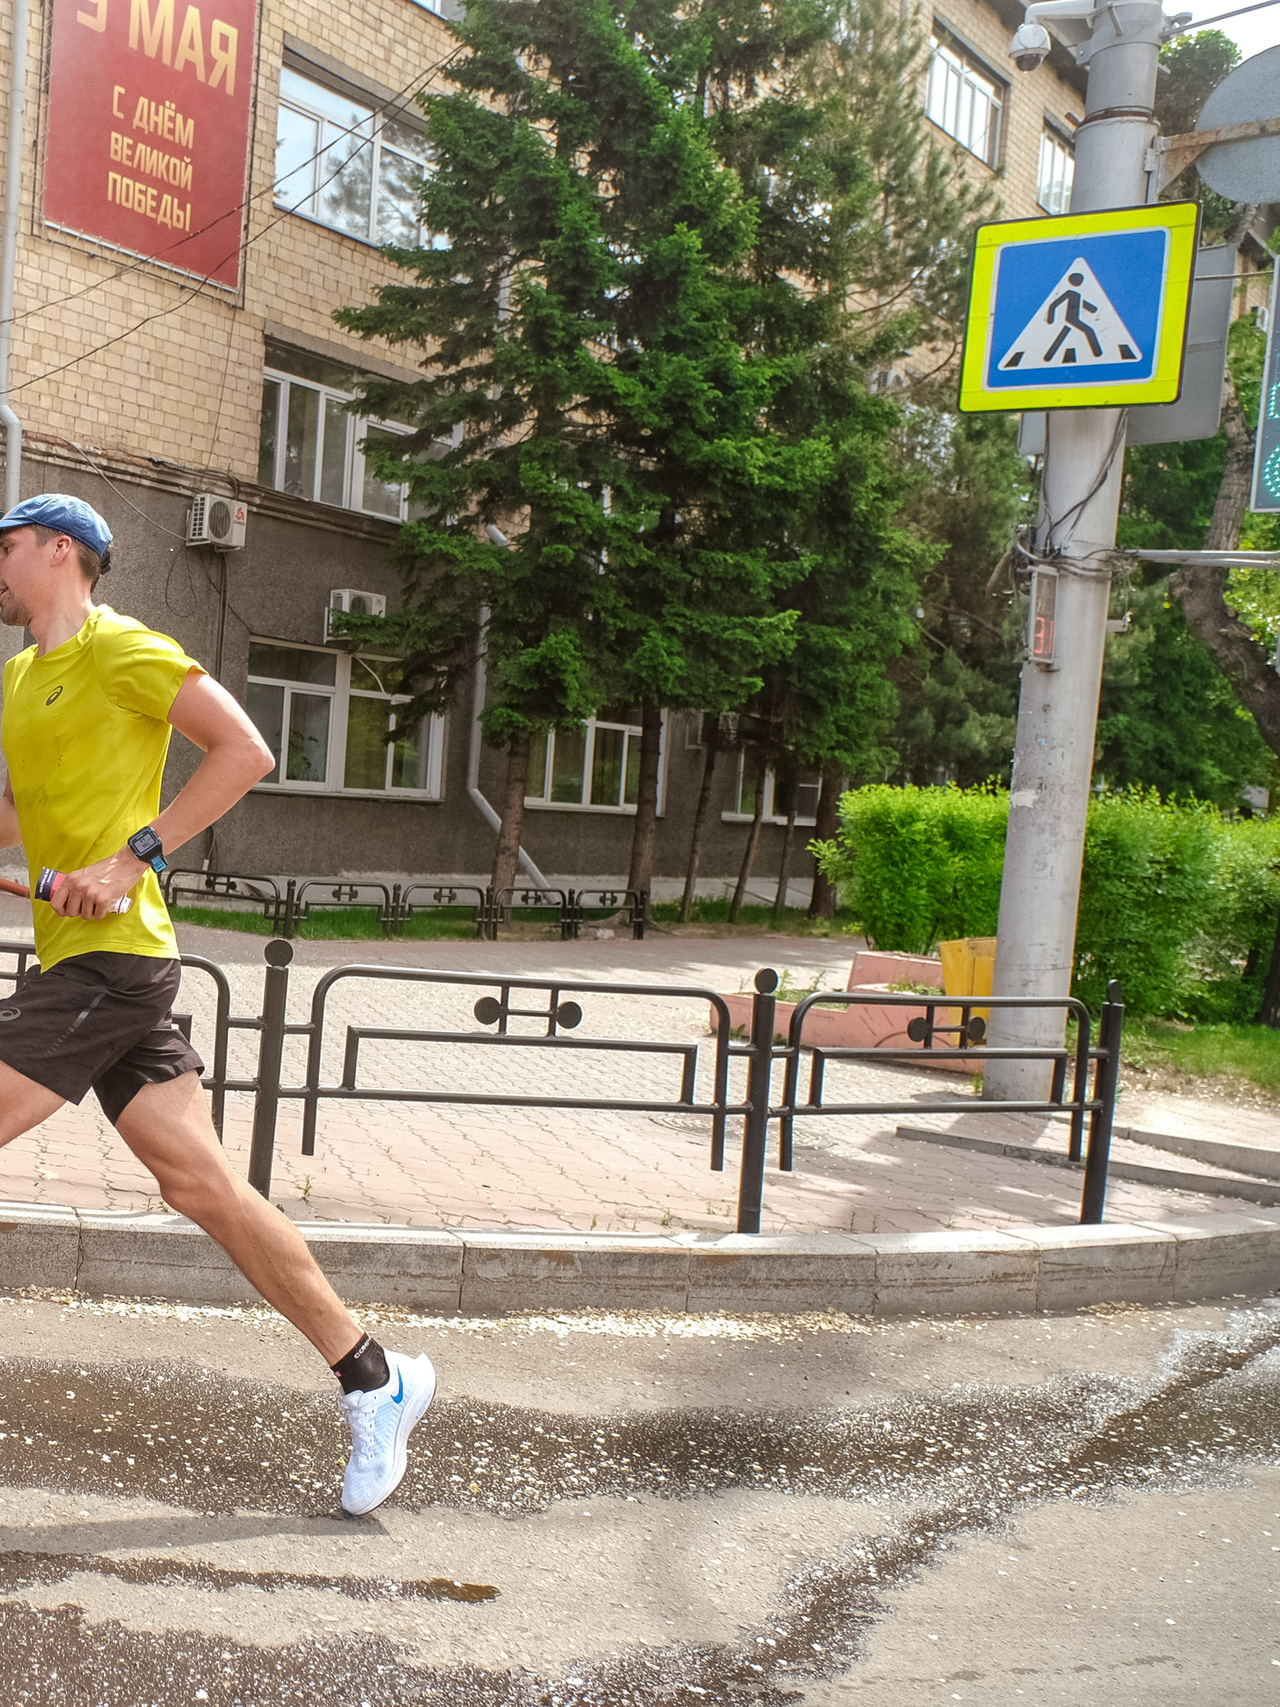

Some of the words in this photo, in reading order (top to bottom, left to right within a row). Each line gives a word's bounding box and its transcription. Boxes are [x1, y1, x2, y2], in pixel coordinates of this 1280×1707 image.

[128, 0, 238, 96] МАЯ
[112, 85, 125, 119] С
[132, 97, 195, 149] ДНЁМ
[110, 131, 193, 191] ВЕЛИКОЙ
[107, 171, 191, 232] ПОБЕДЫ
